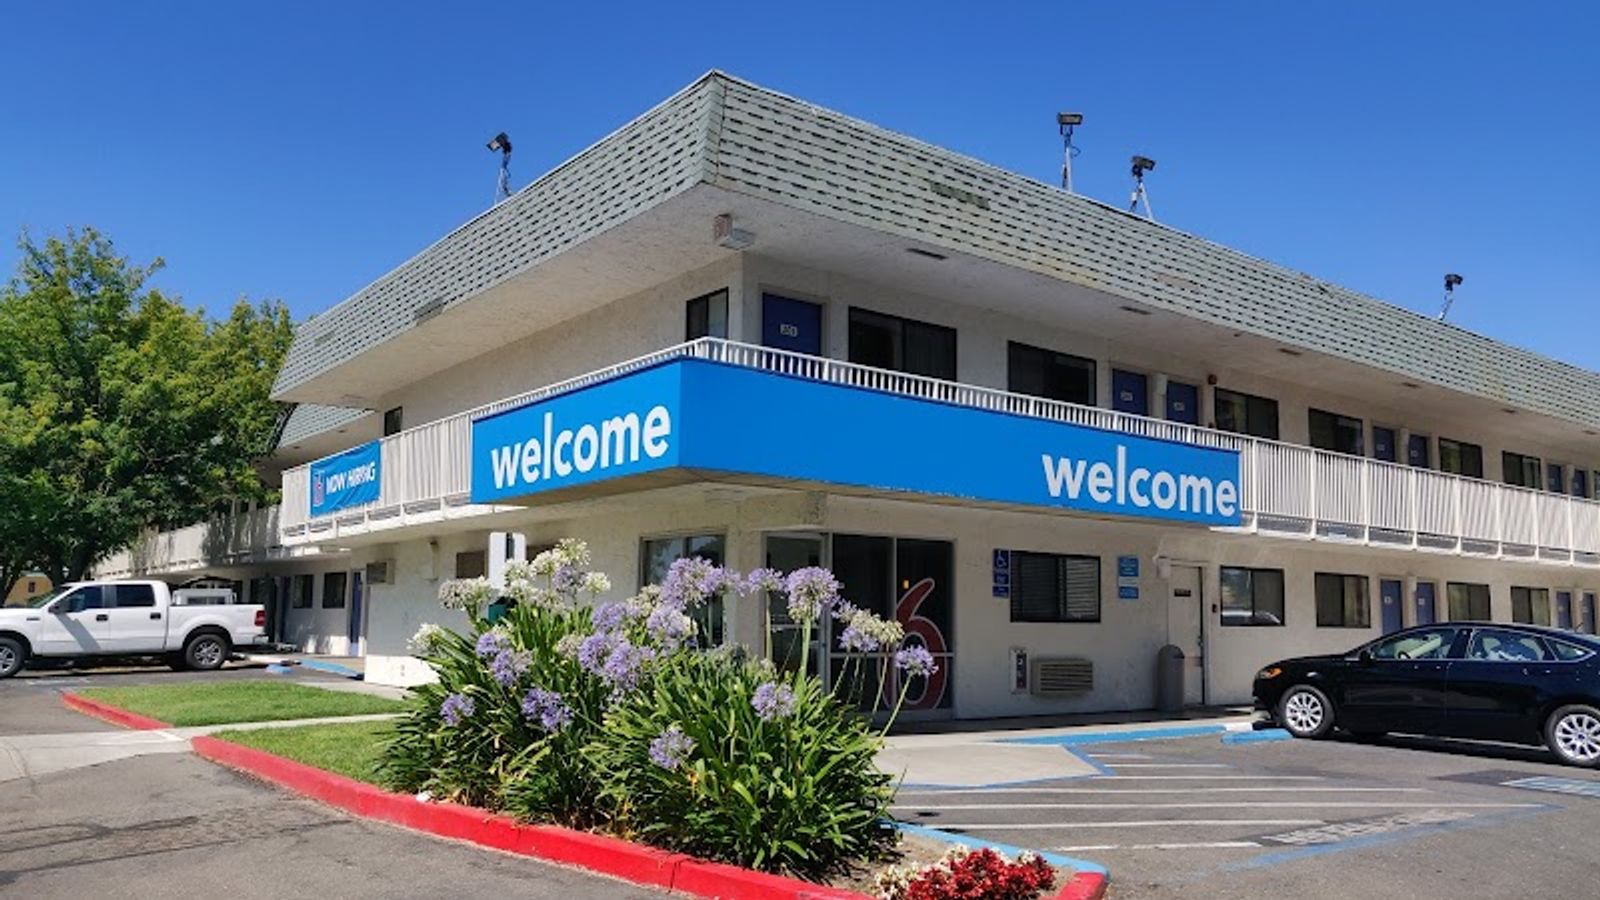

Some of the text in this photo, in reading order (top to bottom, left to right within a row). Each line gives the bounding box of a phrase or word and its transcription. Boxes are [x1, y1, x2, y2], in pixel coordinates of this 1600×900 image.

[326, 471, 347, 495] NOW
[491, 405, 671, 489] welcome
[1041, 445, 1237, 517] welcome
[877, 578, 948, 710] 6
